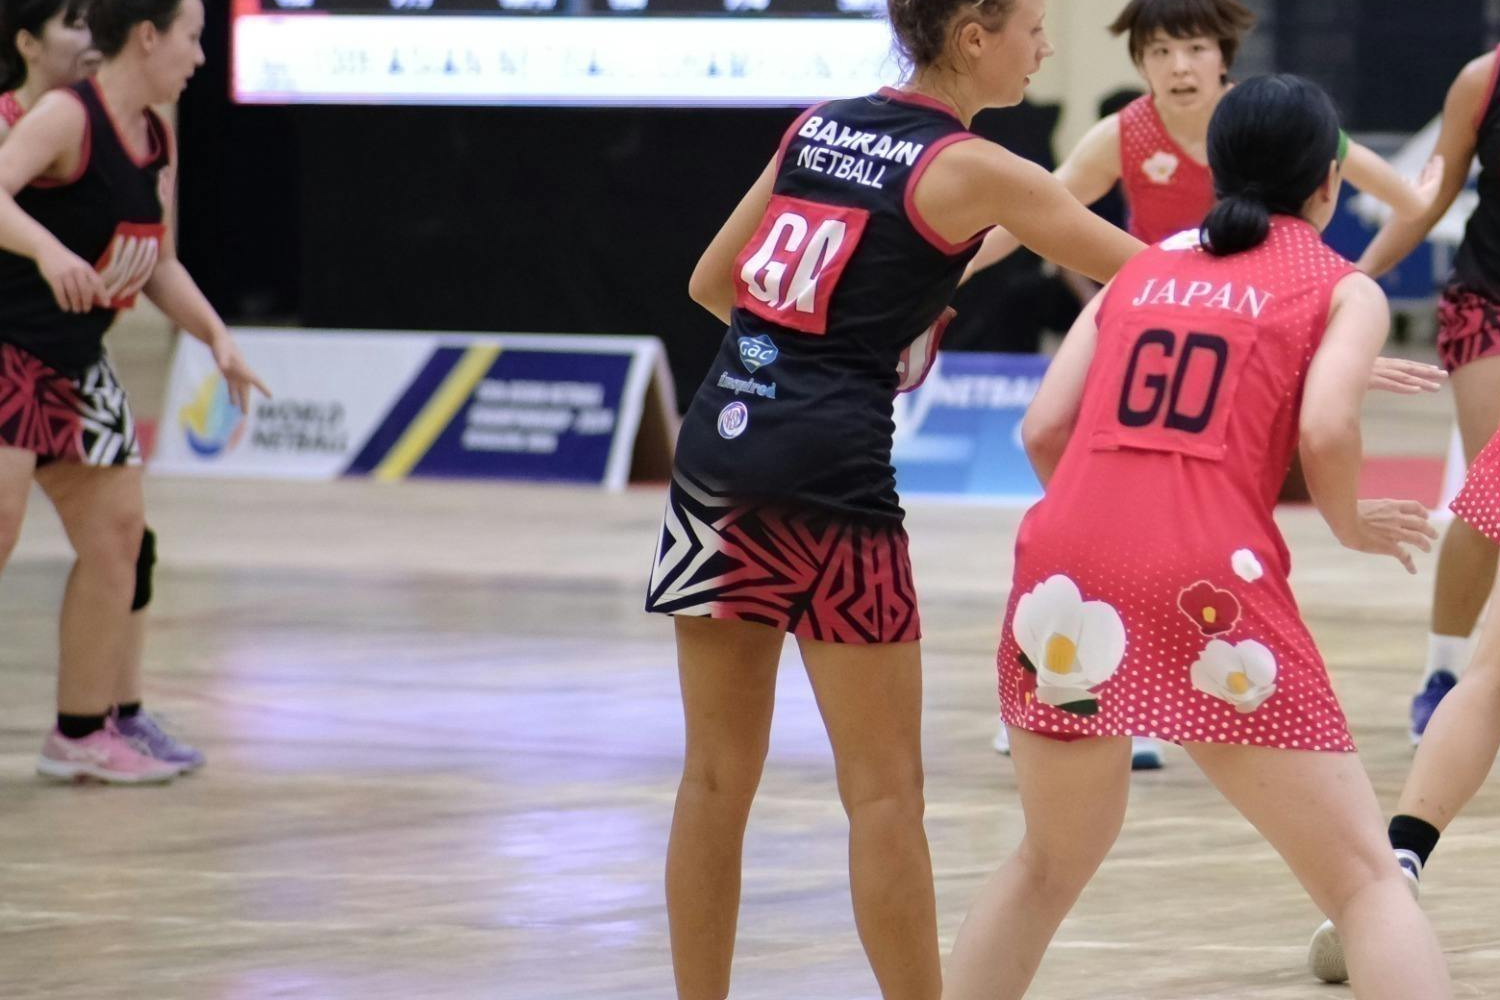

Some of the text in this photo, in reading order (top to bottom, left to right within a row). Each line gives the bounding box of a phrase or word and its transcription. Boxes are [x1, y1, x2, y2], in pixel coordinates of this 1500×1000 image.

[797, 144, 888, 189] NETBALL
[798, 115, 923, 167] BAHRAIN
[741, 211, 846, 315] GA
[1132, 278, 1274, 319] JAPAN
[1117, 328, 1229, 434] GD
